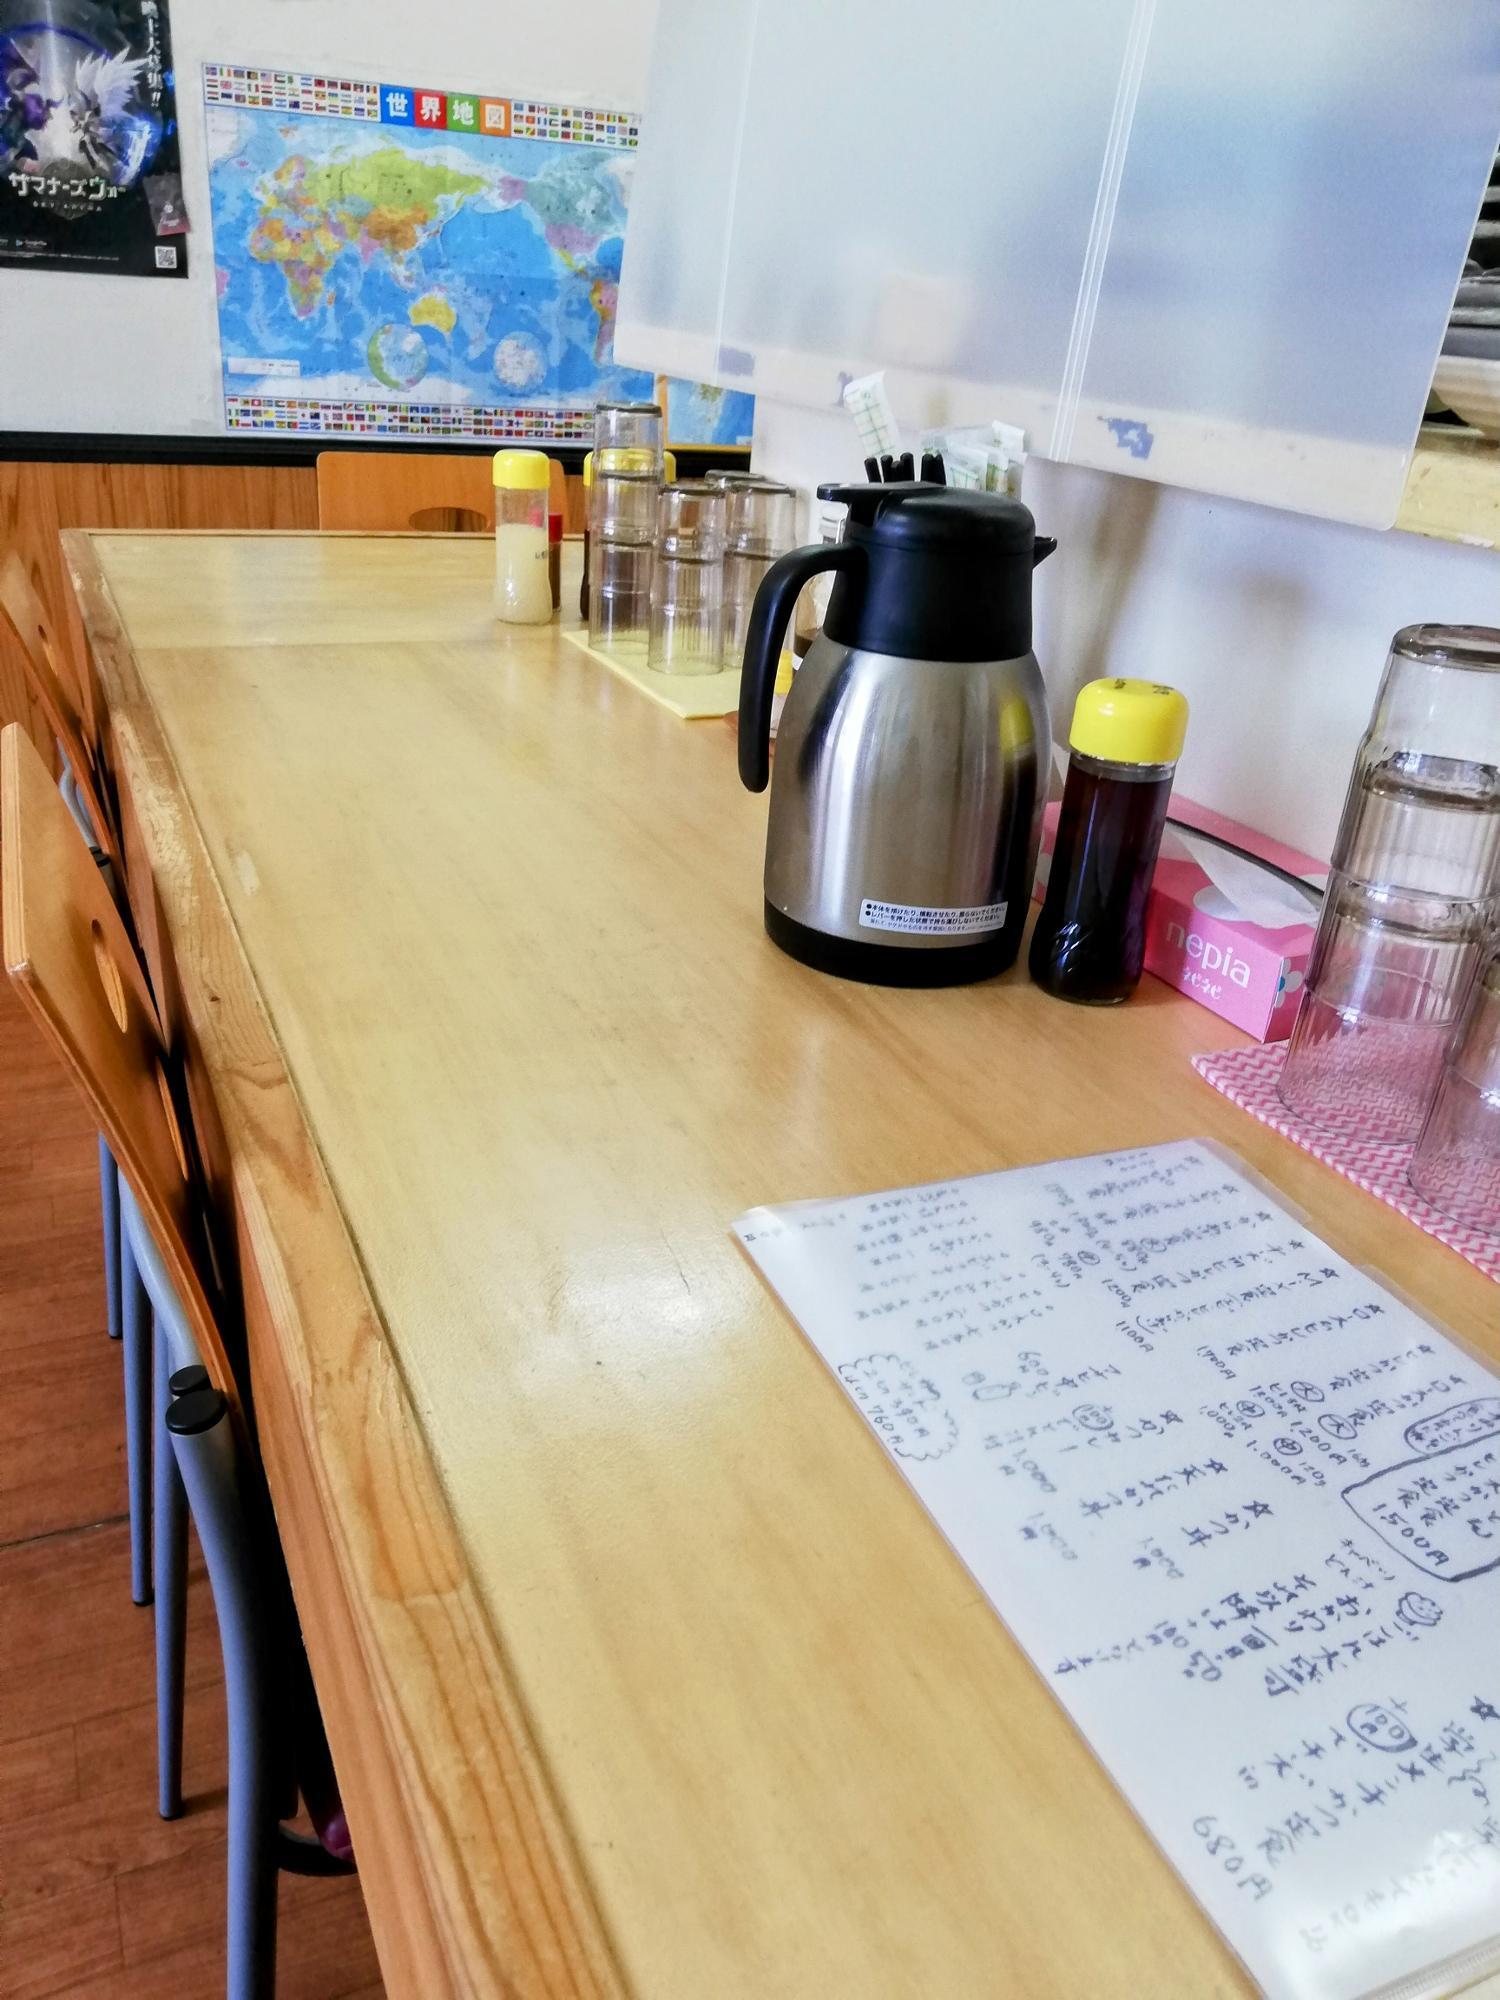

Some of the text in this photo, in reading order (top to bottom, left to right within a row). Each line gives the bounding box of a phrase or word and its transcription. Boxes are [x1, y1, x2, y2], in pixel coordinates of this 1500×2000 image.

[386, 92, 505, 130] 世界地図
[1166, 921, 1251, 989] nepia
